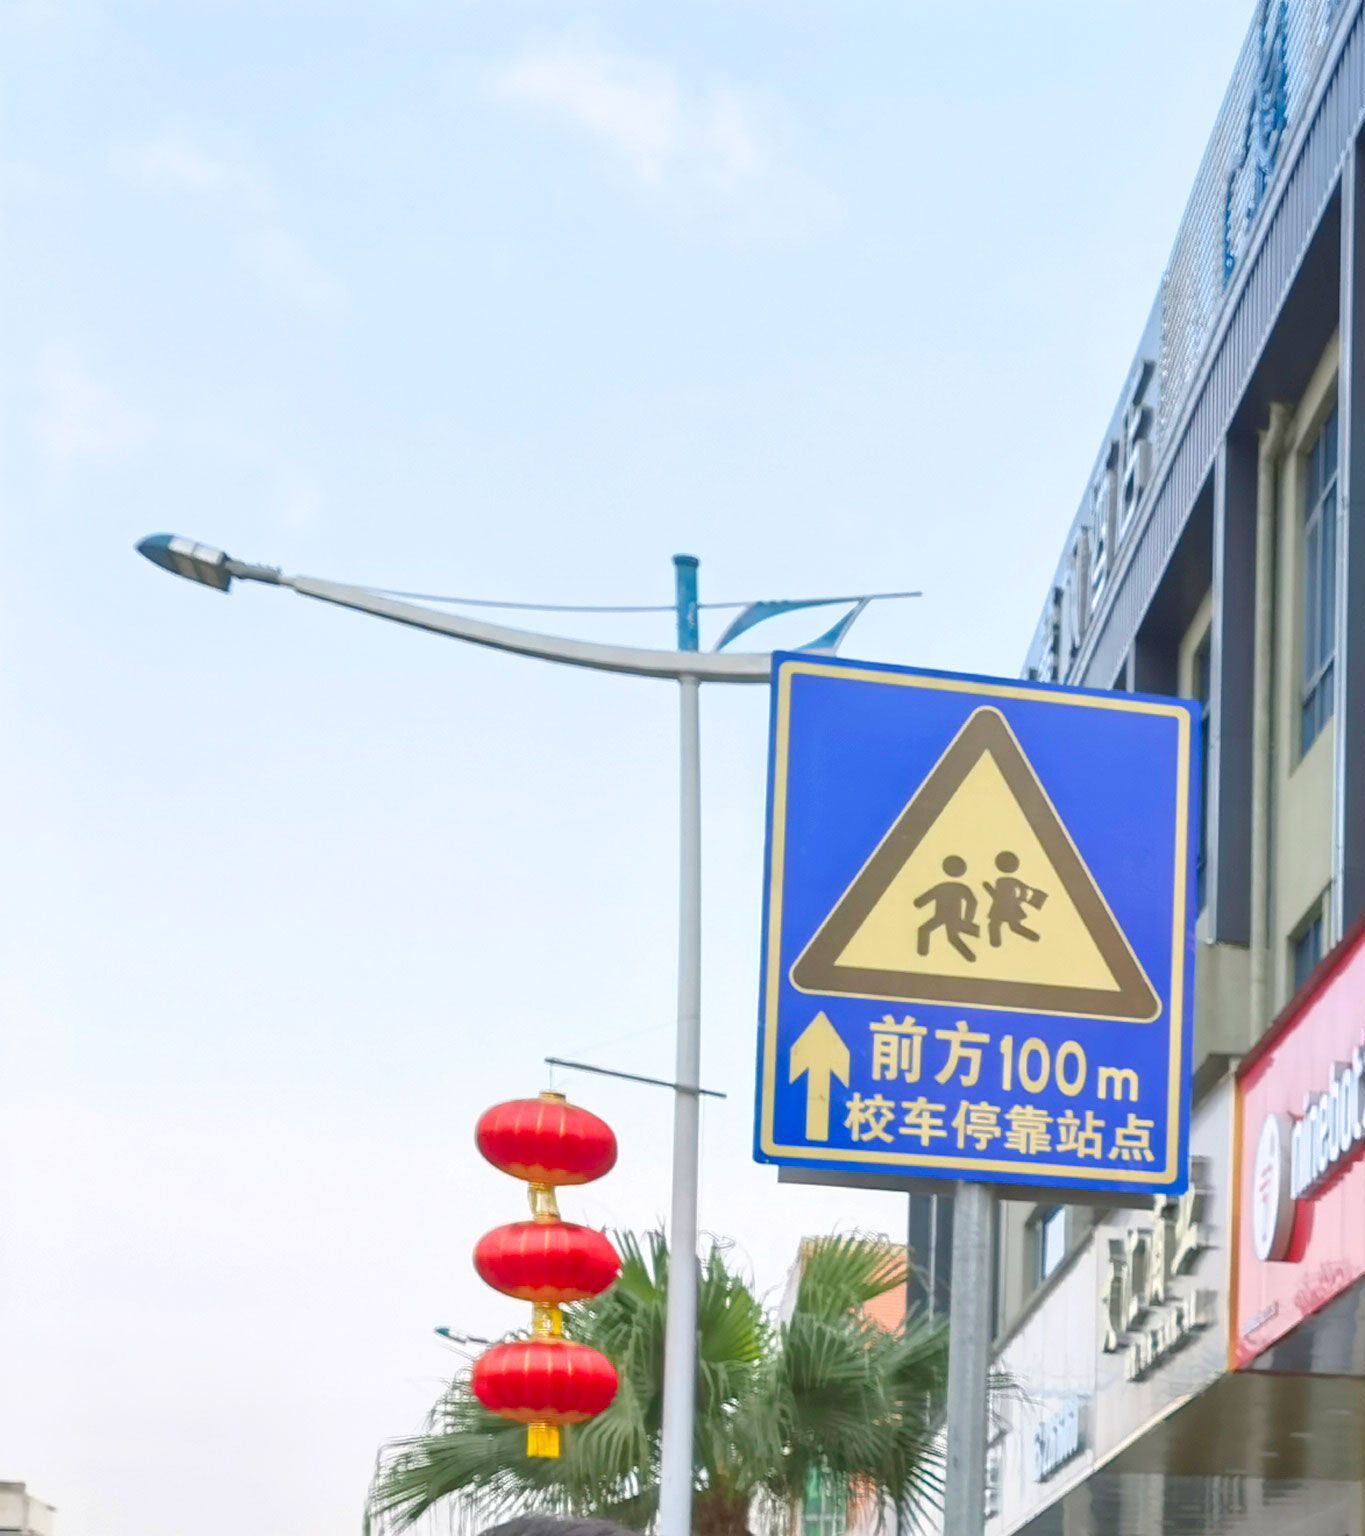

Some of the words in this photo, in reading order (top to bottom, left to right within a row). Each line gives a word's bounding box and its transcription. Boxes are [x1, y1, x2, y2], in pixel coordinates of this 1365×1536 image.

[843, 1091, 1156, 1163] 校车停靠站点
